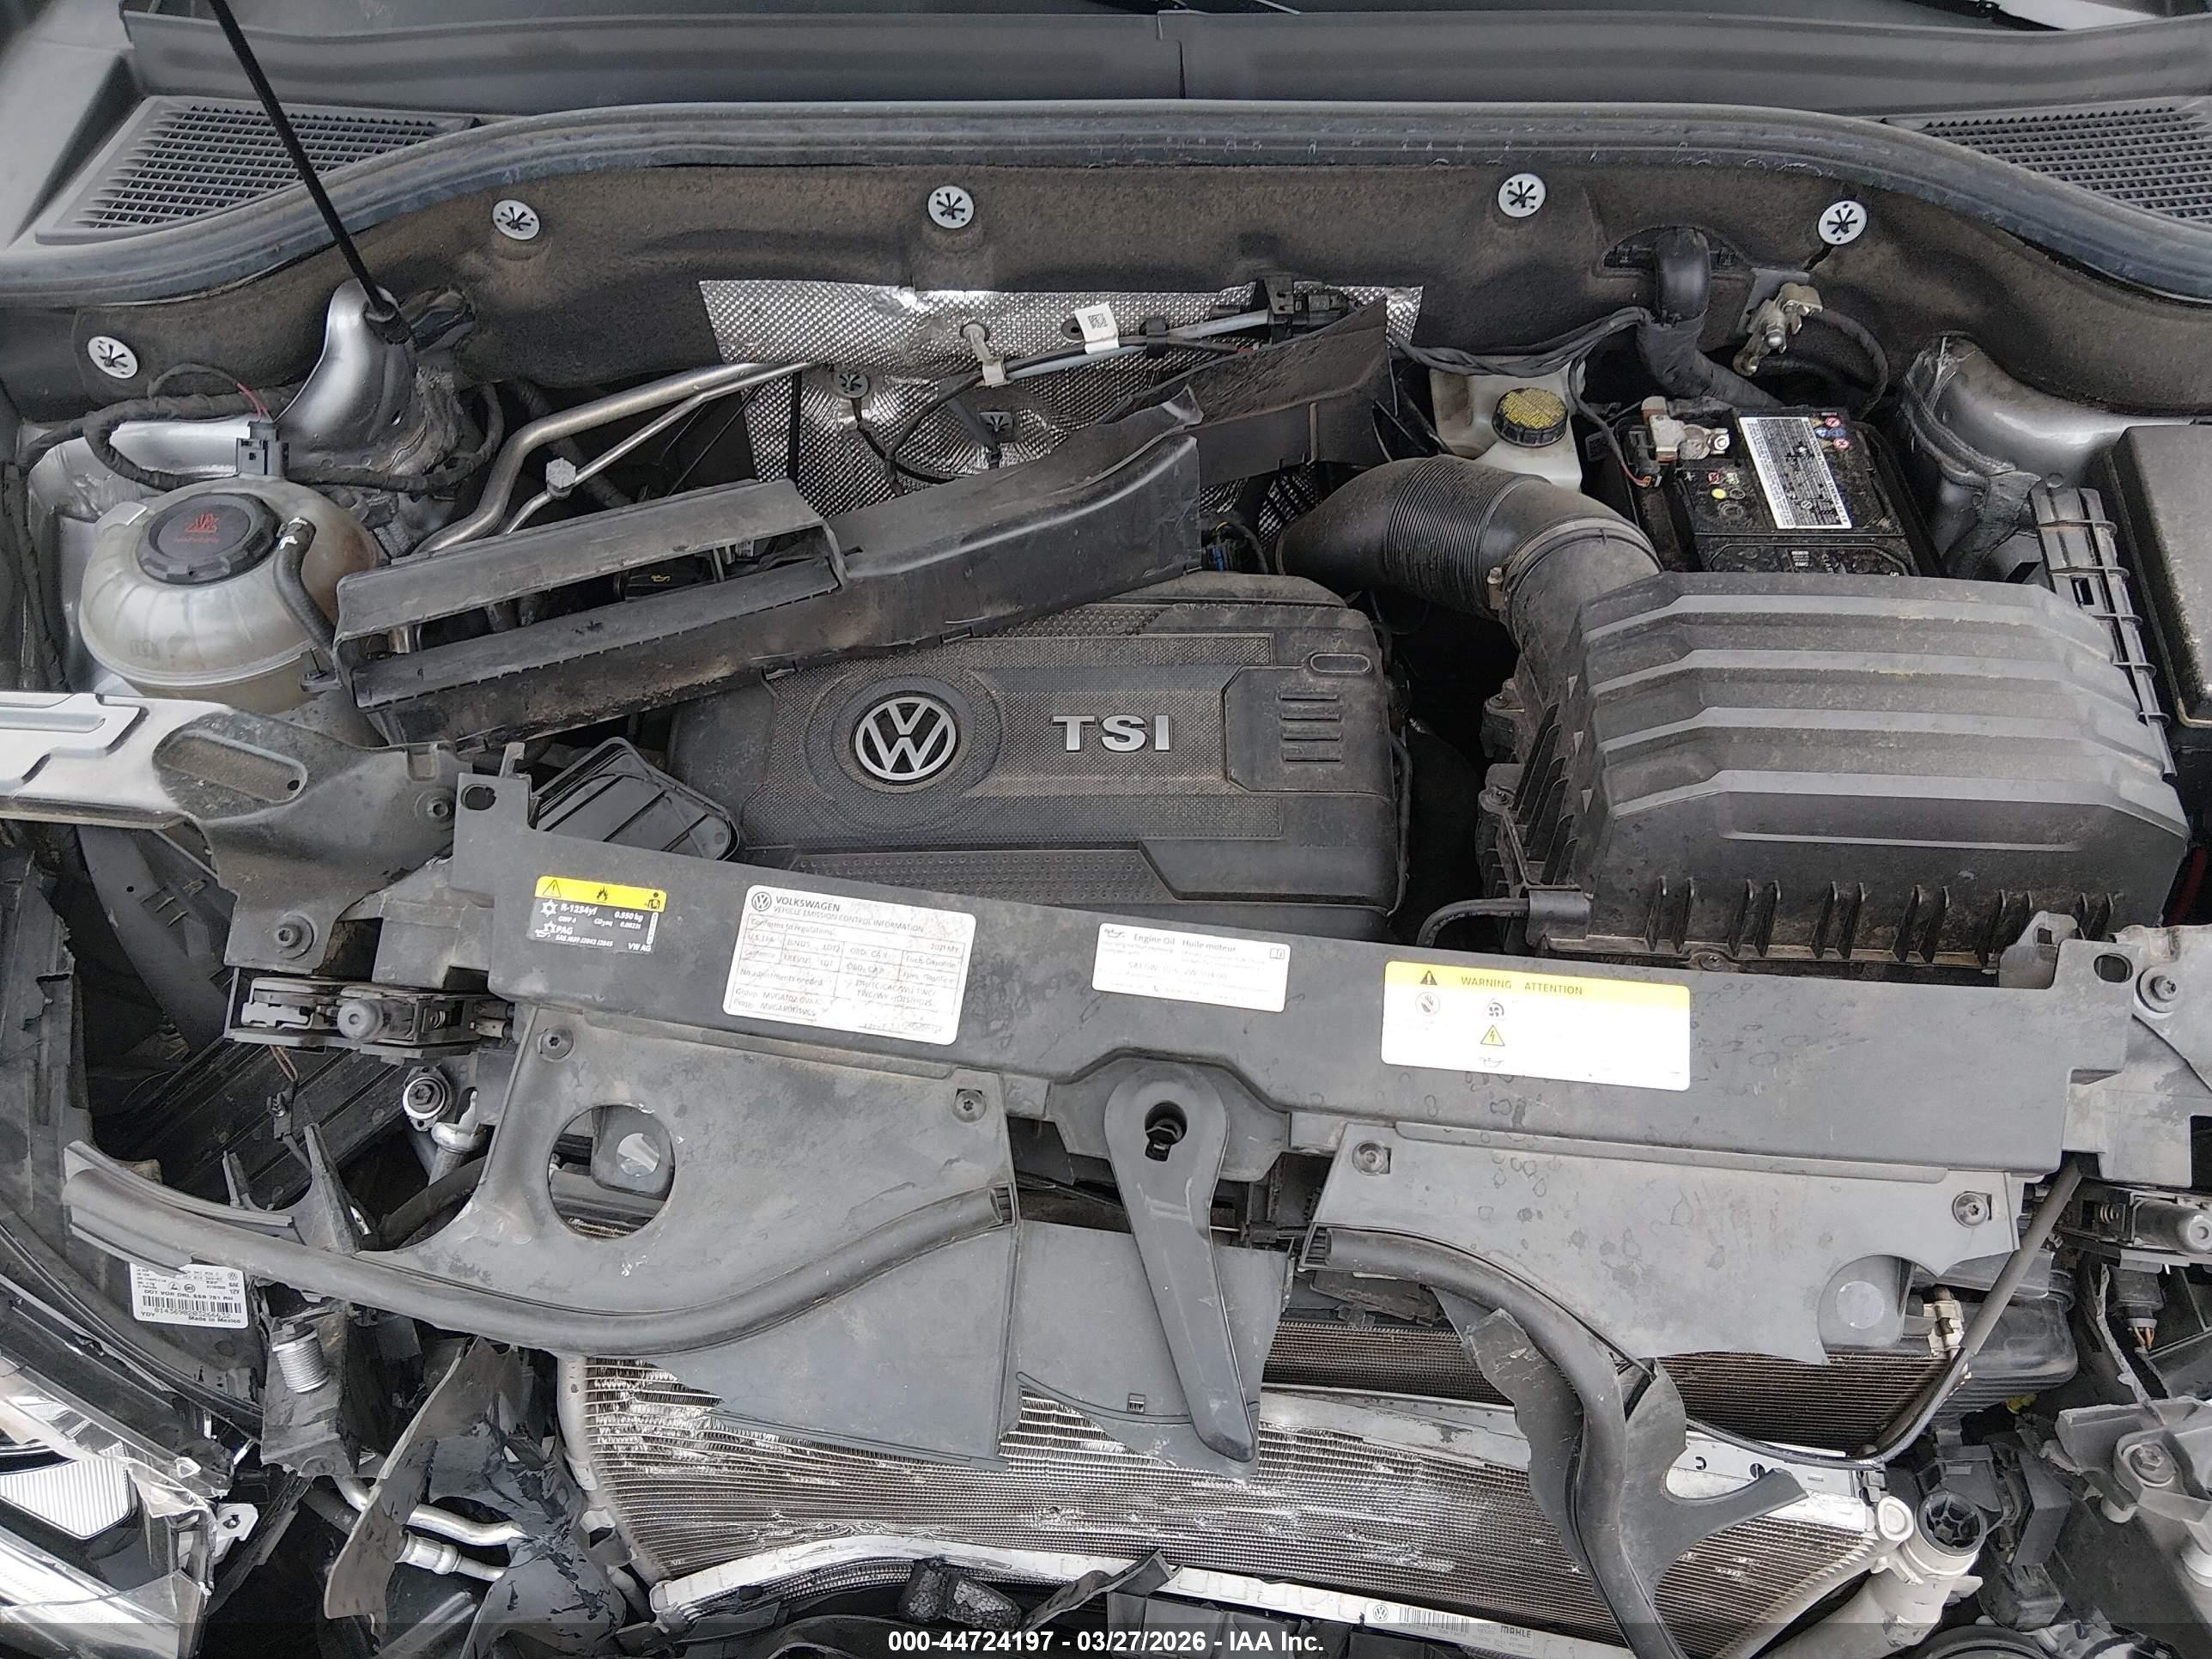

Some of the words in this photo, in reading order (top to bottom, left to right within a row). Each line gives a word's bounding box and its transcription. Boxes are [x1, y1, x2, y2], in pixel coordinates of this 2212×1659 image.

[1052, 714, 1170, 753] TSI
[561, 903, 599, 917] R-1234yf
[634, 912, 644, 921] kg
[775, 896, 841, 912] VOLKSWAGEN
[750, 918, 784, 929] Conforms
[773, 906, 802, 916] VEHICLE
[803, 910, 837, 921] EMISSION
[838, 915, 872, 926] CONTROL
[872, 920, 924, 933] INFORMATION
[556, 924, 574, 936] PAG
[628, 942, 641, 951] VW
[640, 943, 652, 952] AG
[1133, 933, 1162, 945] Engine
[1163, 937, 1176, 945] Oil
[1182, 939, 1205, 950] Huile
[1205, 941, 1237, 952] moteur
[1461, 975, 1512, 990] WARNING
[1524, 981, 1583, 996] ATTENTION
[1500, 1625, 1532, 1638] MAHLE
